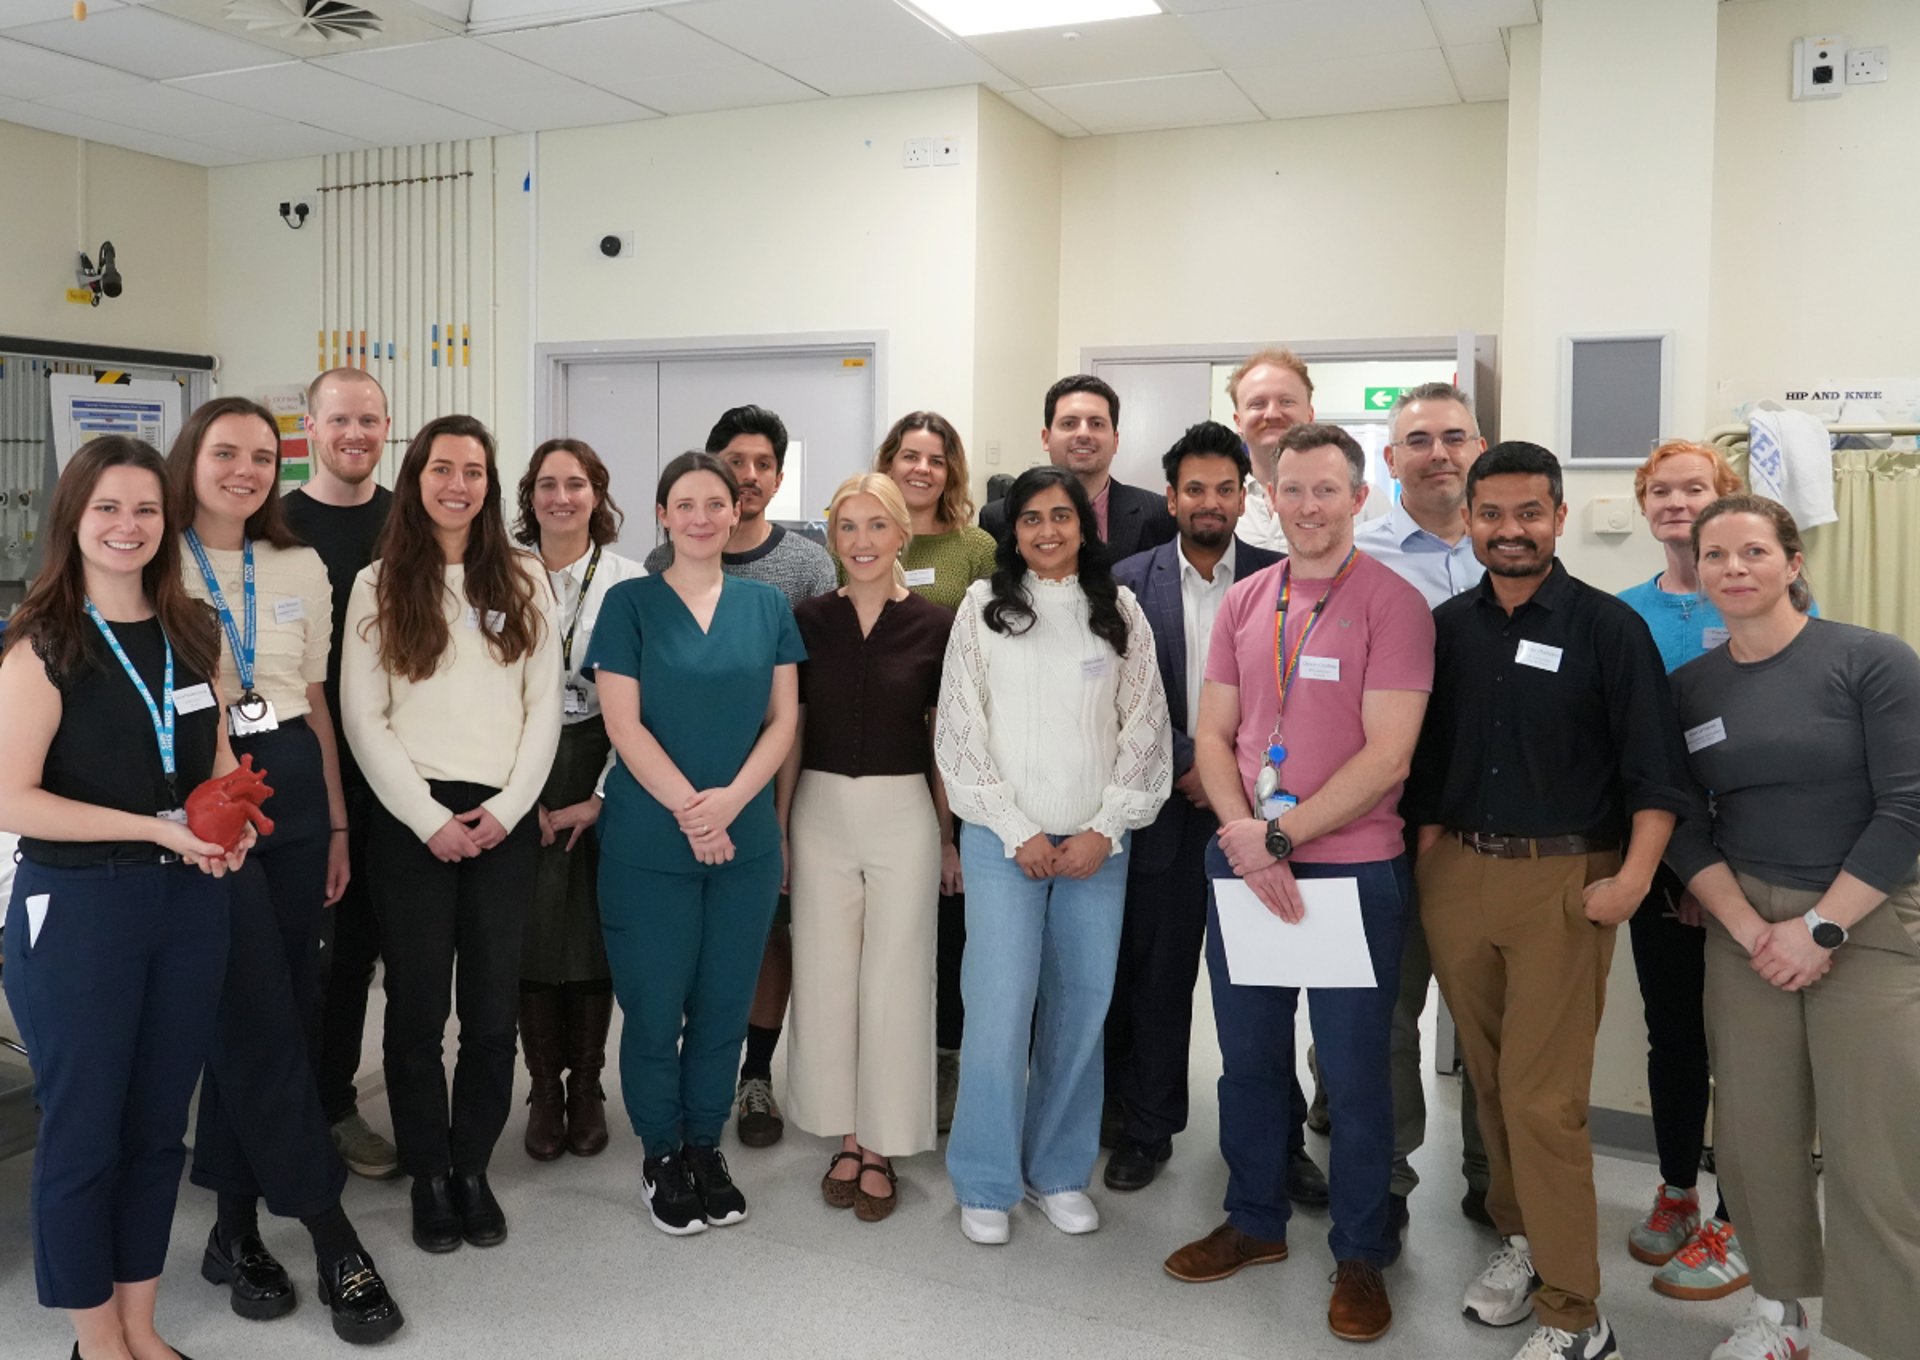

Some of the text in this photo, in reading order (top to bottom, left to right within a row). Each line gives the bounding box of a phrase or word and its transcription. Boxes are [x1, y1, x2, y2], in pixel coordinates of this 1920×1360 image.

[1785, 391, 1882, 401] HIP AND KNEE
